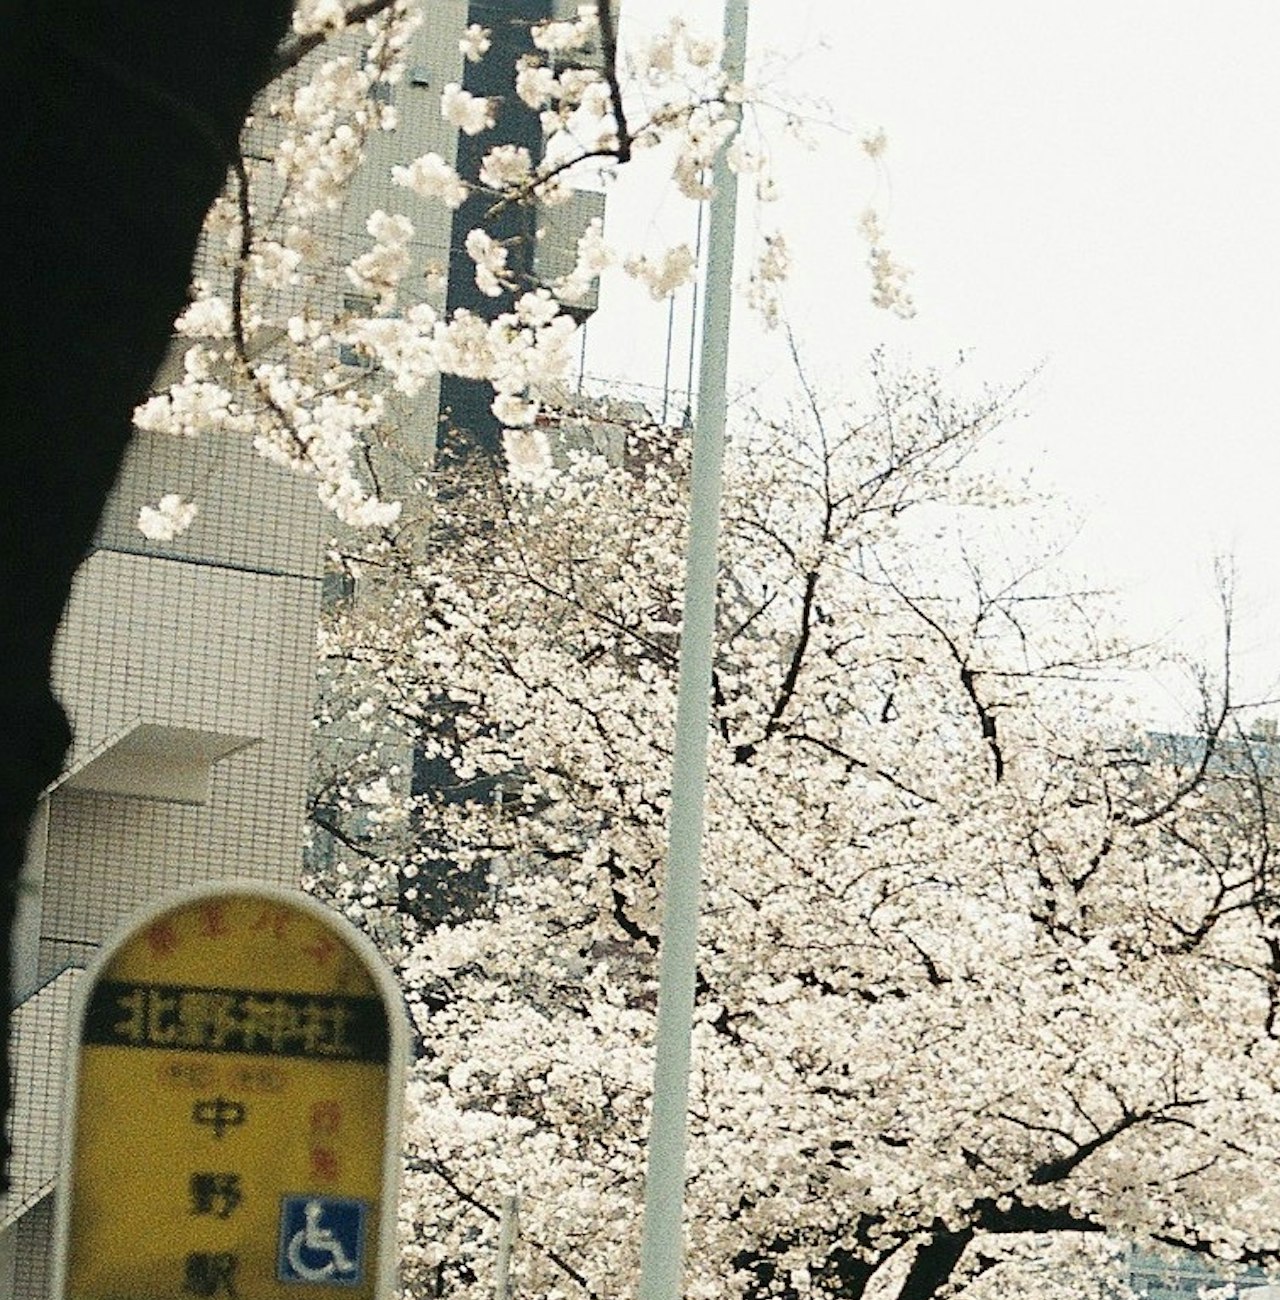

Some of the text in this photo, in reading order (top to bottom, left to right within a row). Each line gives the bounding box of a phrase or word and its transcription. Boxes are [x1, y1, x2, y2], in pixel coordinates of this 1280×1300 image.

[113, 988, 347, 1053] 北野神社
[184, 1096, 248, 1298] 中野駅
